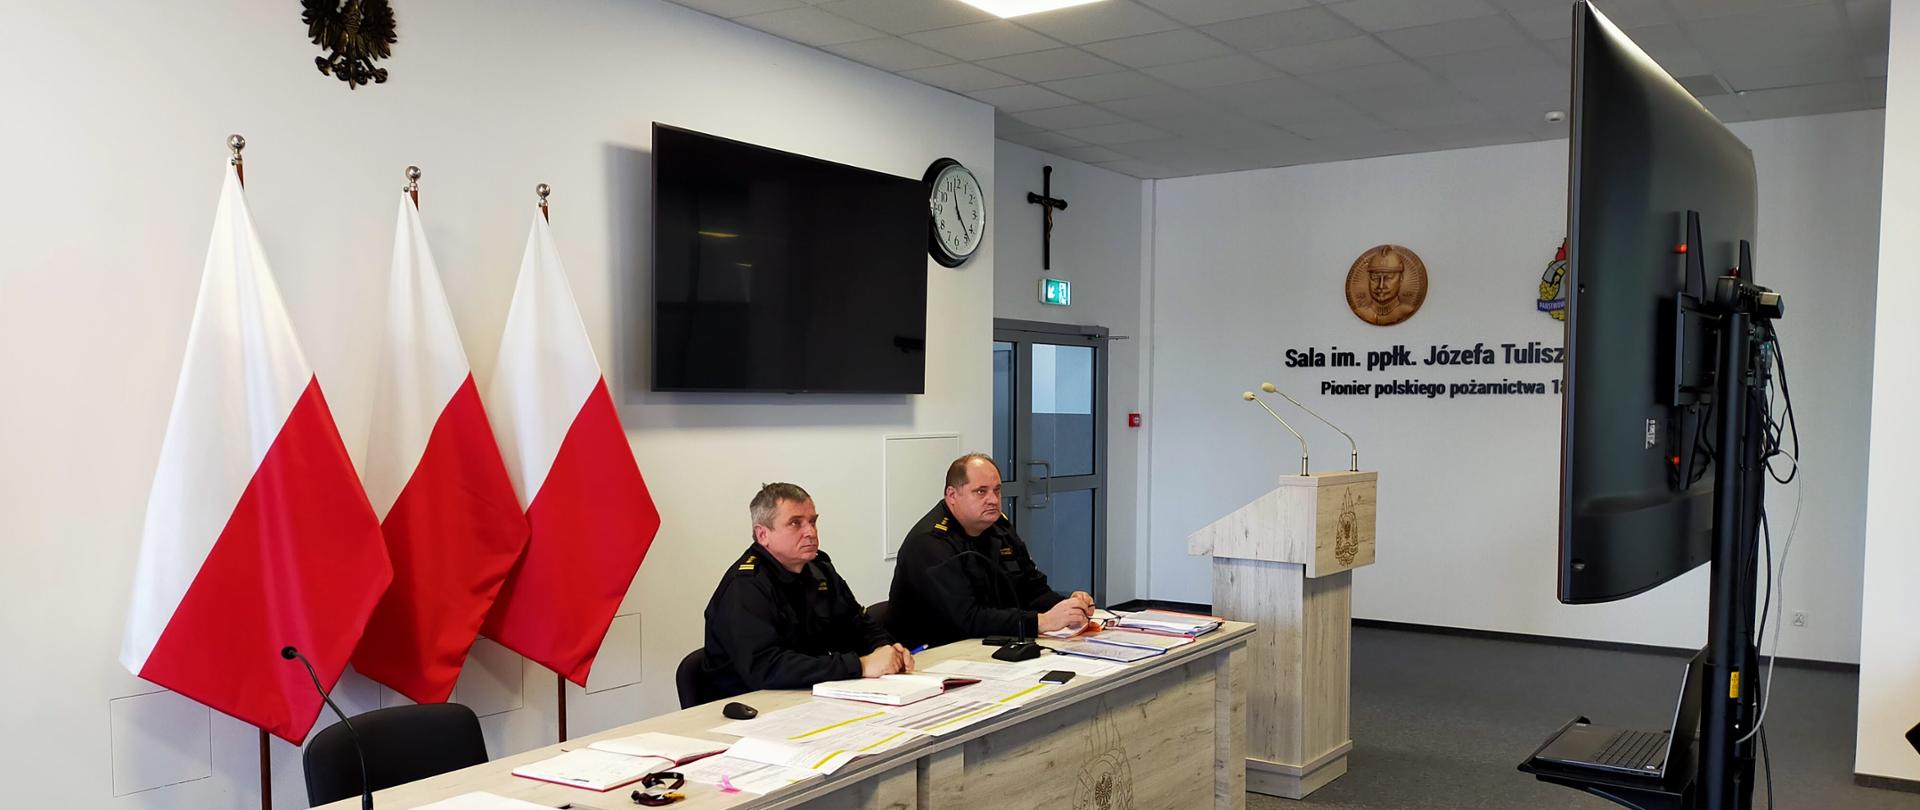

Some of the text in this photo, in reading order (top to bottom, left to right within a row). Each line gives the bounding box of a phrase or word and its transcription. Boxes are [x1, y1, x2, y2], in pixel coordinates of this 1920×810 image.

[1284, 341, 1565, 372] Sala im. ppłk. Józefa Tulisz
[1321, 379, 1372, 396] Pionier
[1374, 378, 1446, 399] polskiego
[1450, 378, 1546, 399] pożarnictwa
